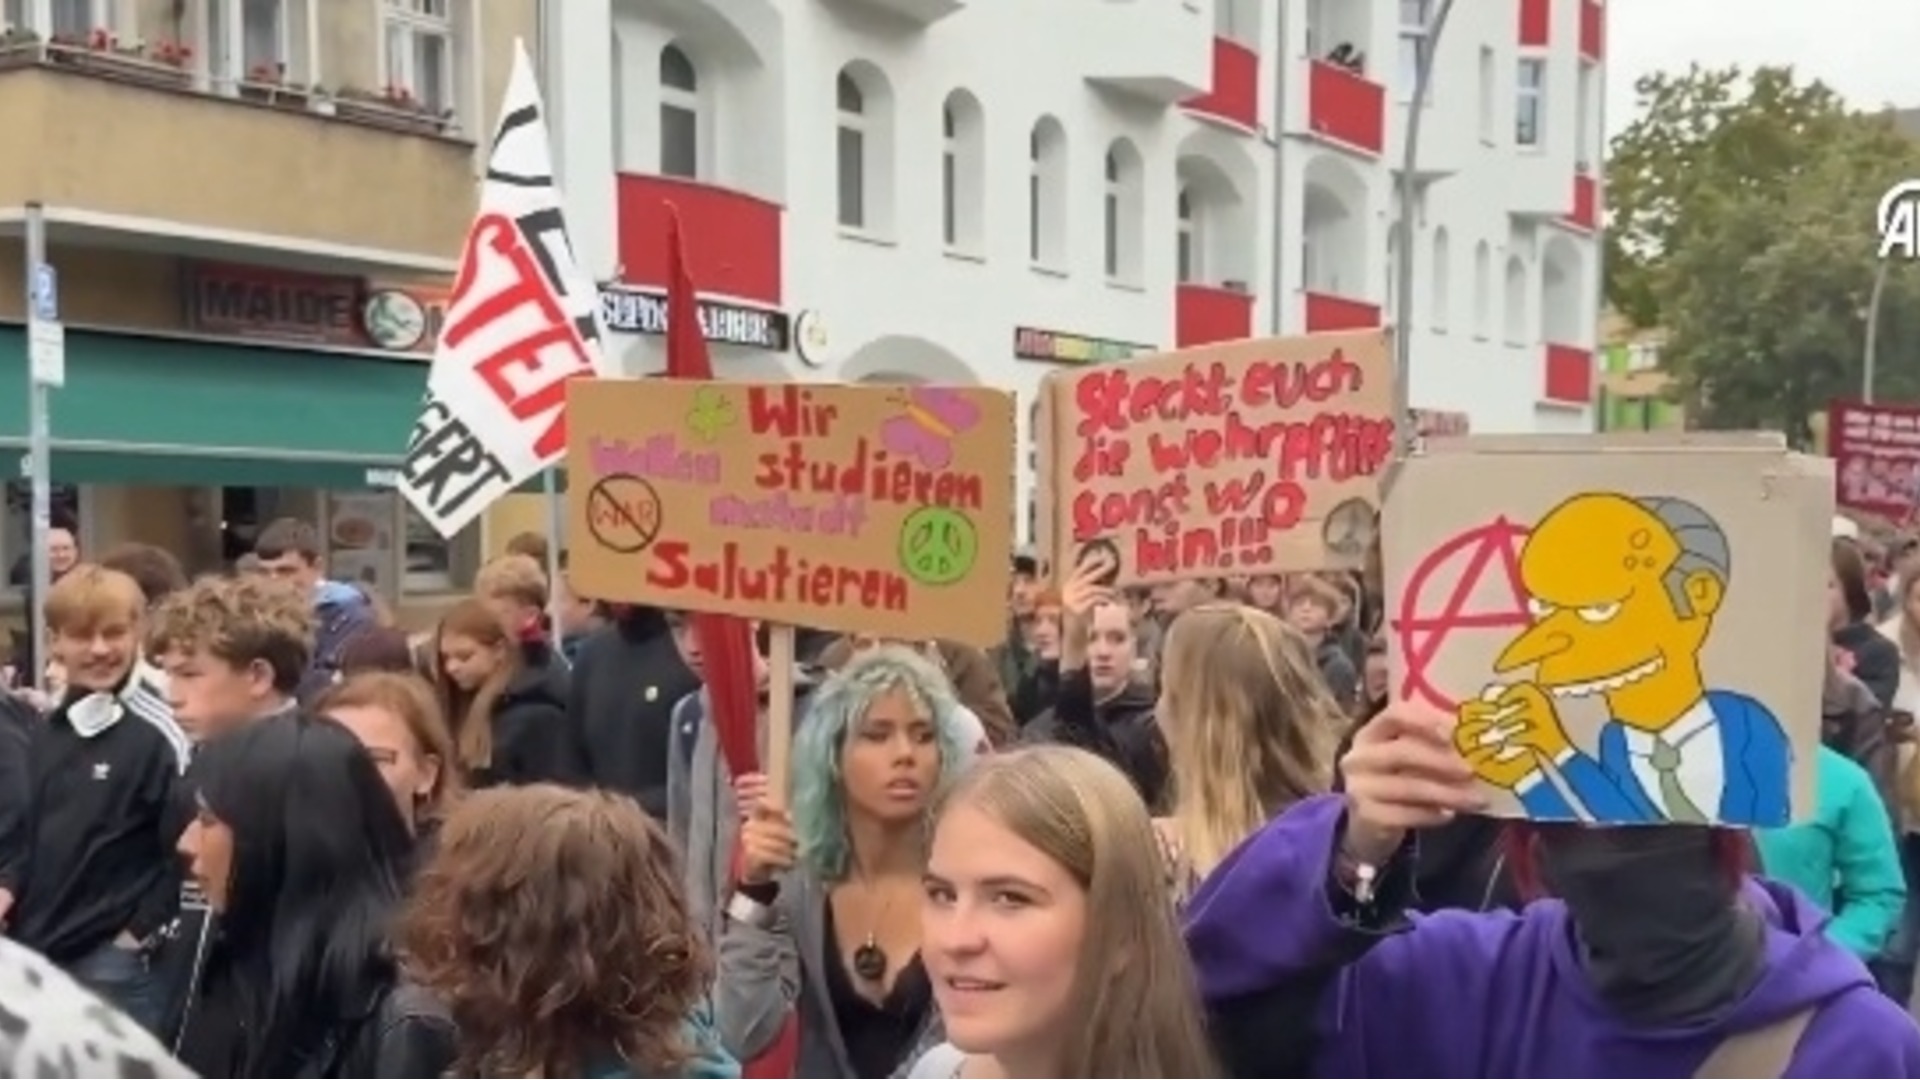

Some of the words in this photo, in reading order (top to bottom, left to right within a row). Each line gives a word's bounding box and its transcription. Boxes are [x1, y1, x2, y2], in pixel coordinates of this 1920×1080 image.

[1241, 349, 1362, 406] euch
[749, 385, 837, 437] Wir
[755, 438, 982, 508] studieren
[646, 541, 908, 611] Salutieren
